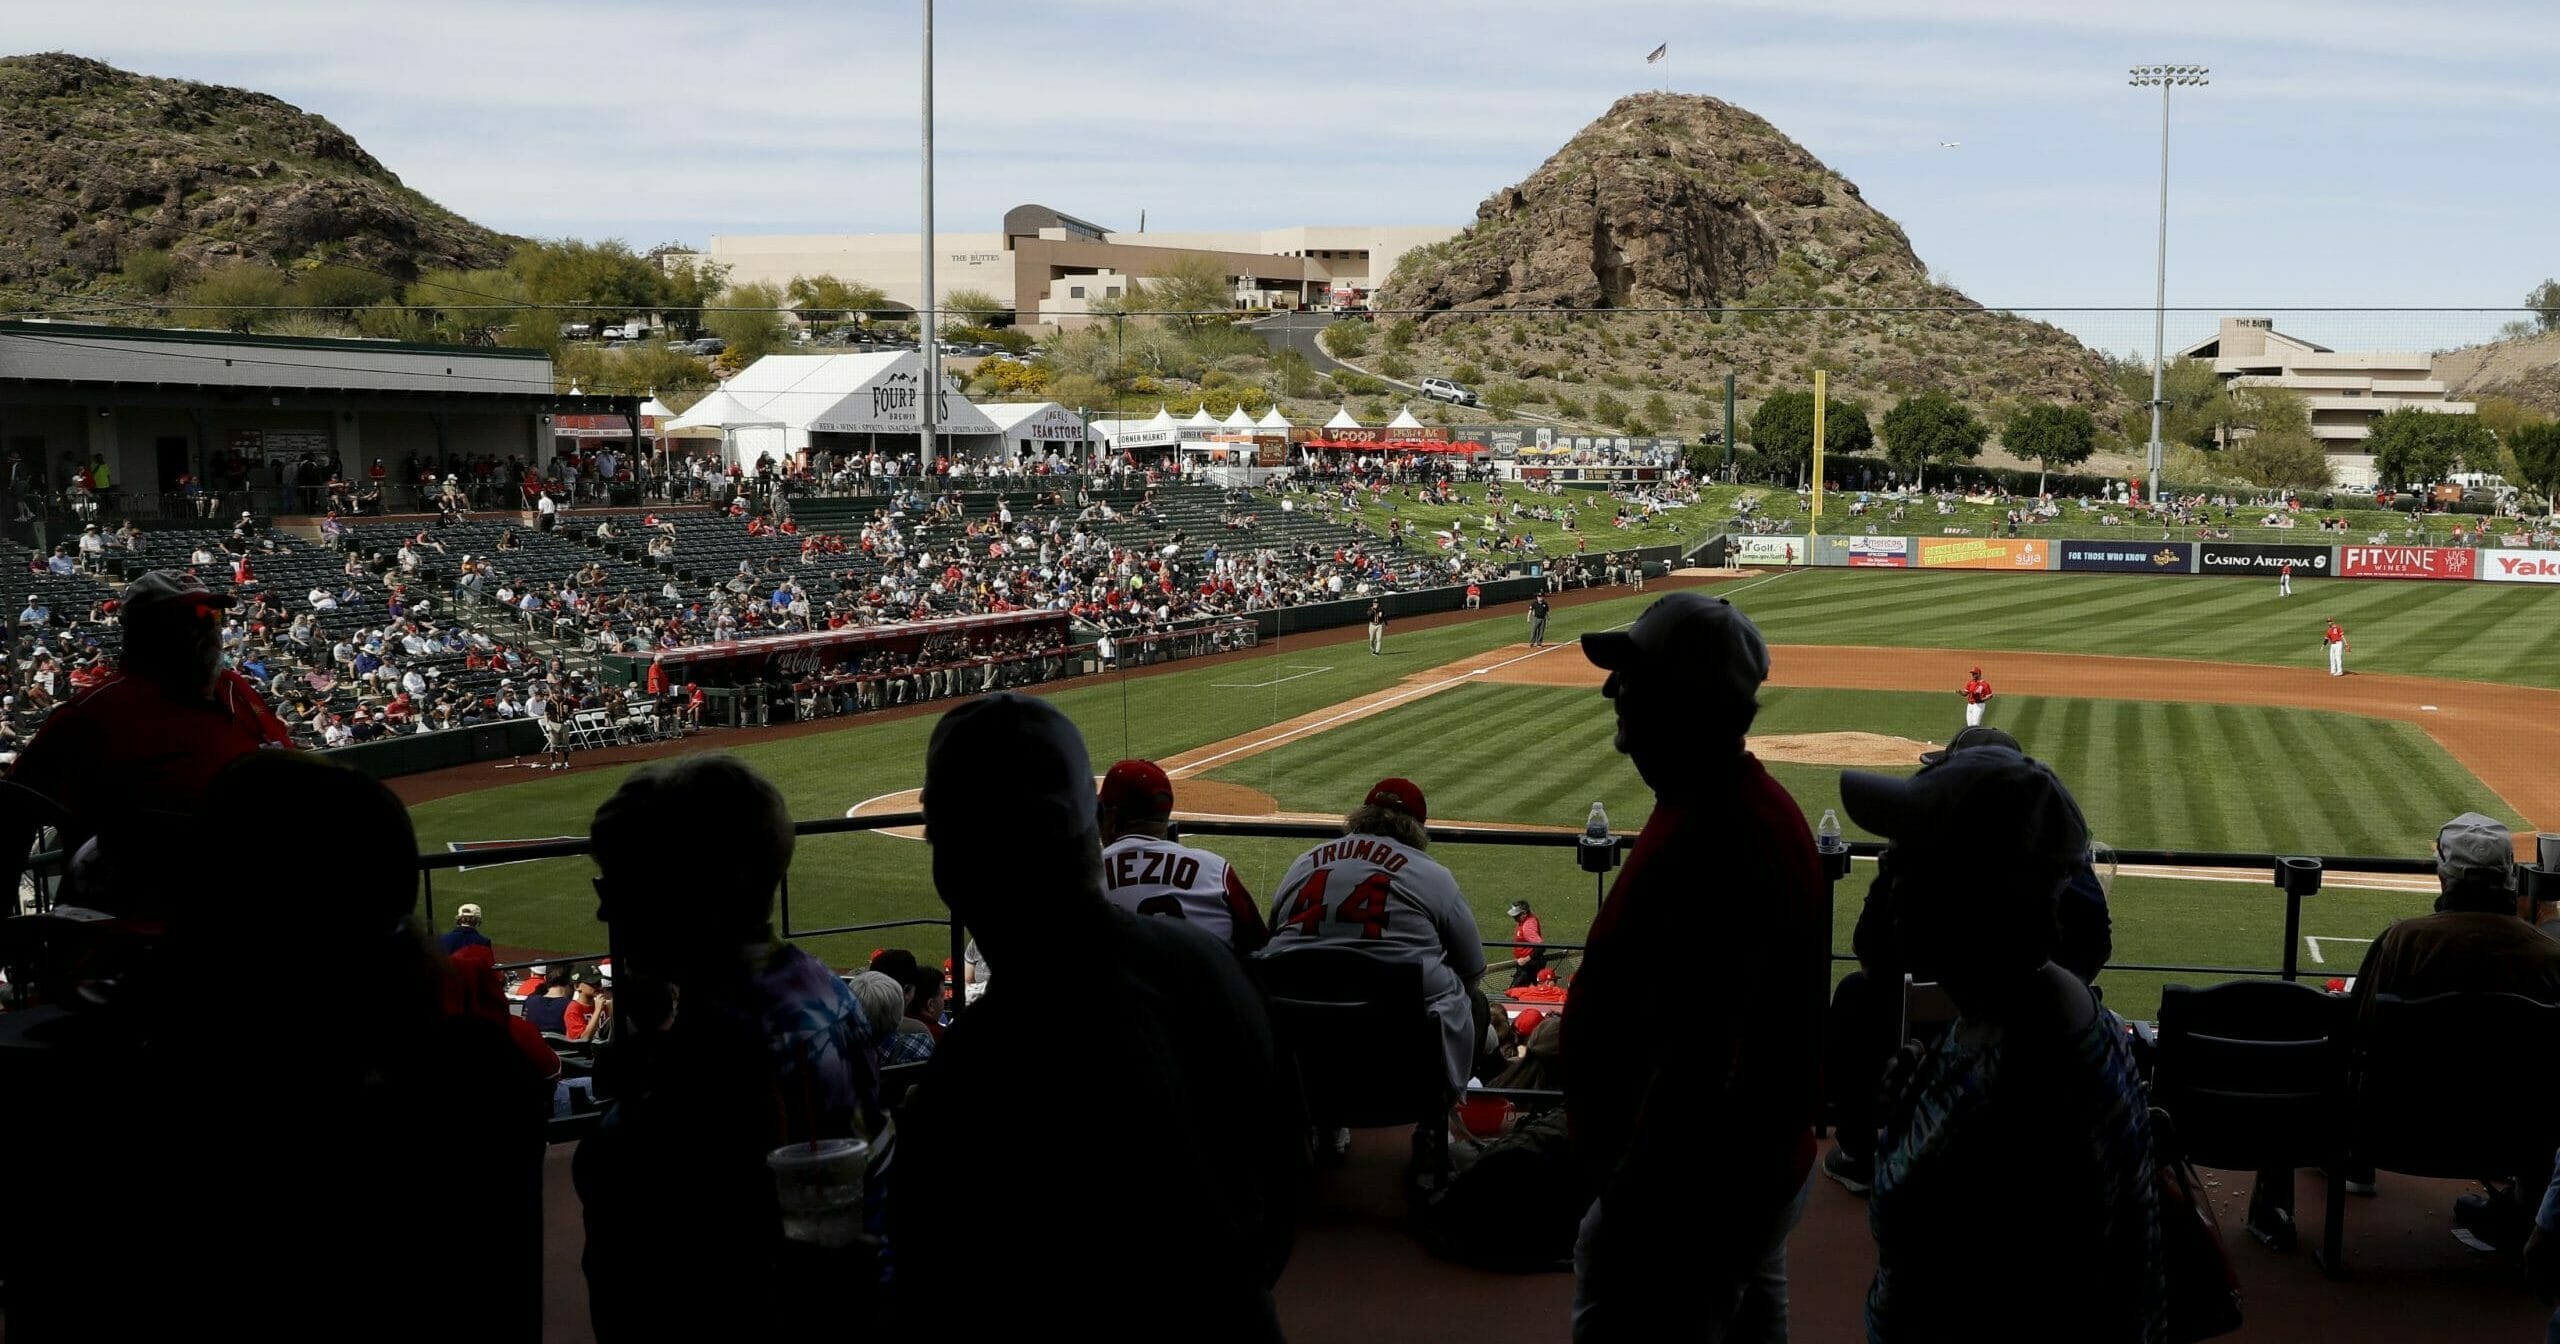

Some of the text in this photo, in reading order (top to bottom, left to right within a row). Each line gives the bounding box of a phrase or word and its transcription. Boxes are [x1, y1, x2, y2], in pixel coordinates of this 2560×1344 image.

[2236, 319, 2250, 328] THE
[872, 386, 906, 419] FOUR
[1031, 425, 1083, 439] TEAM STORE
[1116, 433, 1167, 444] CORNER MARKET
[2068, 551, 2147, 562] FOR THOSE WHO KNOW
[2204, 553, 2310, 567] CASINO ARIZONA
[2445, 557, 2467, 566] YOUR
[2447, 550, 2464, 559] LIVE
[2374, 564, 2407, 572] WINES
[2496, 557, 2560, 576] Yak
[1309, 839, 1409, 873] TRUMBO
[1104, 851, 1201, 892] IEZIO
[1286, 868, 1392, 940] 44
